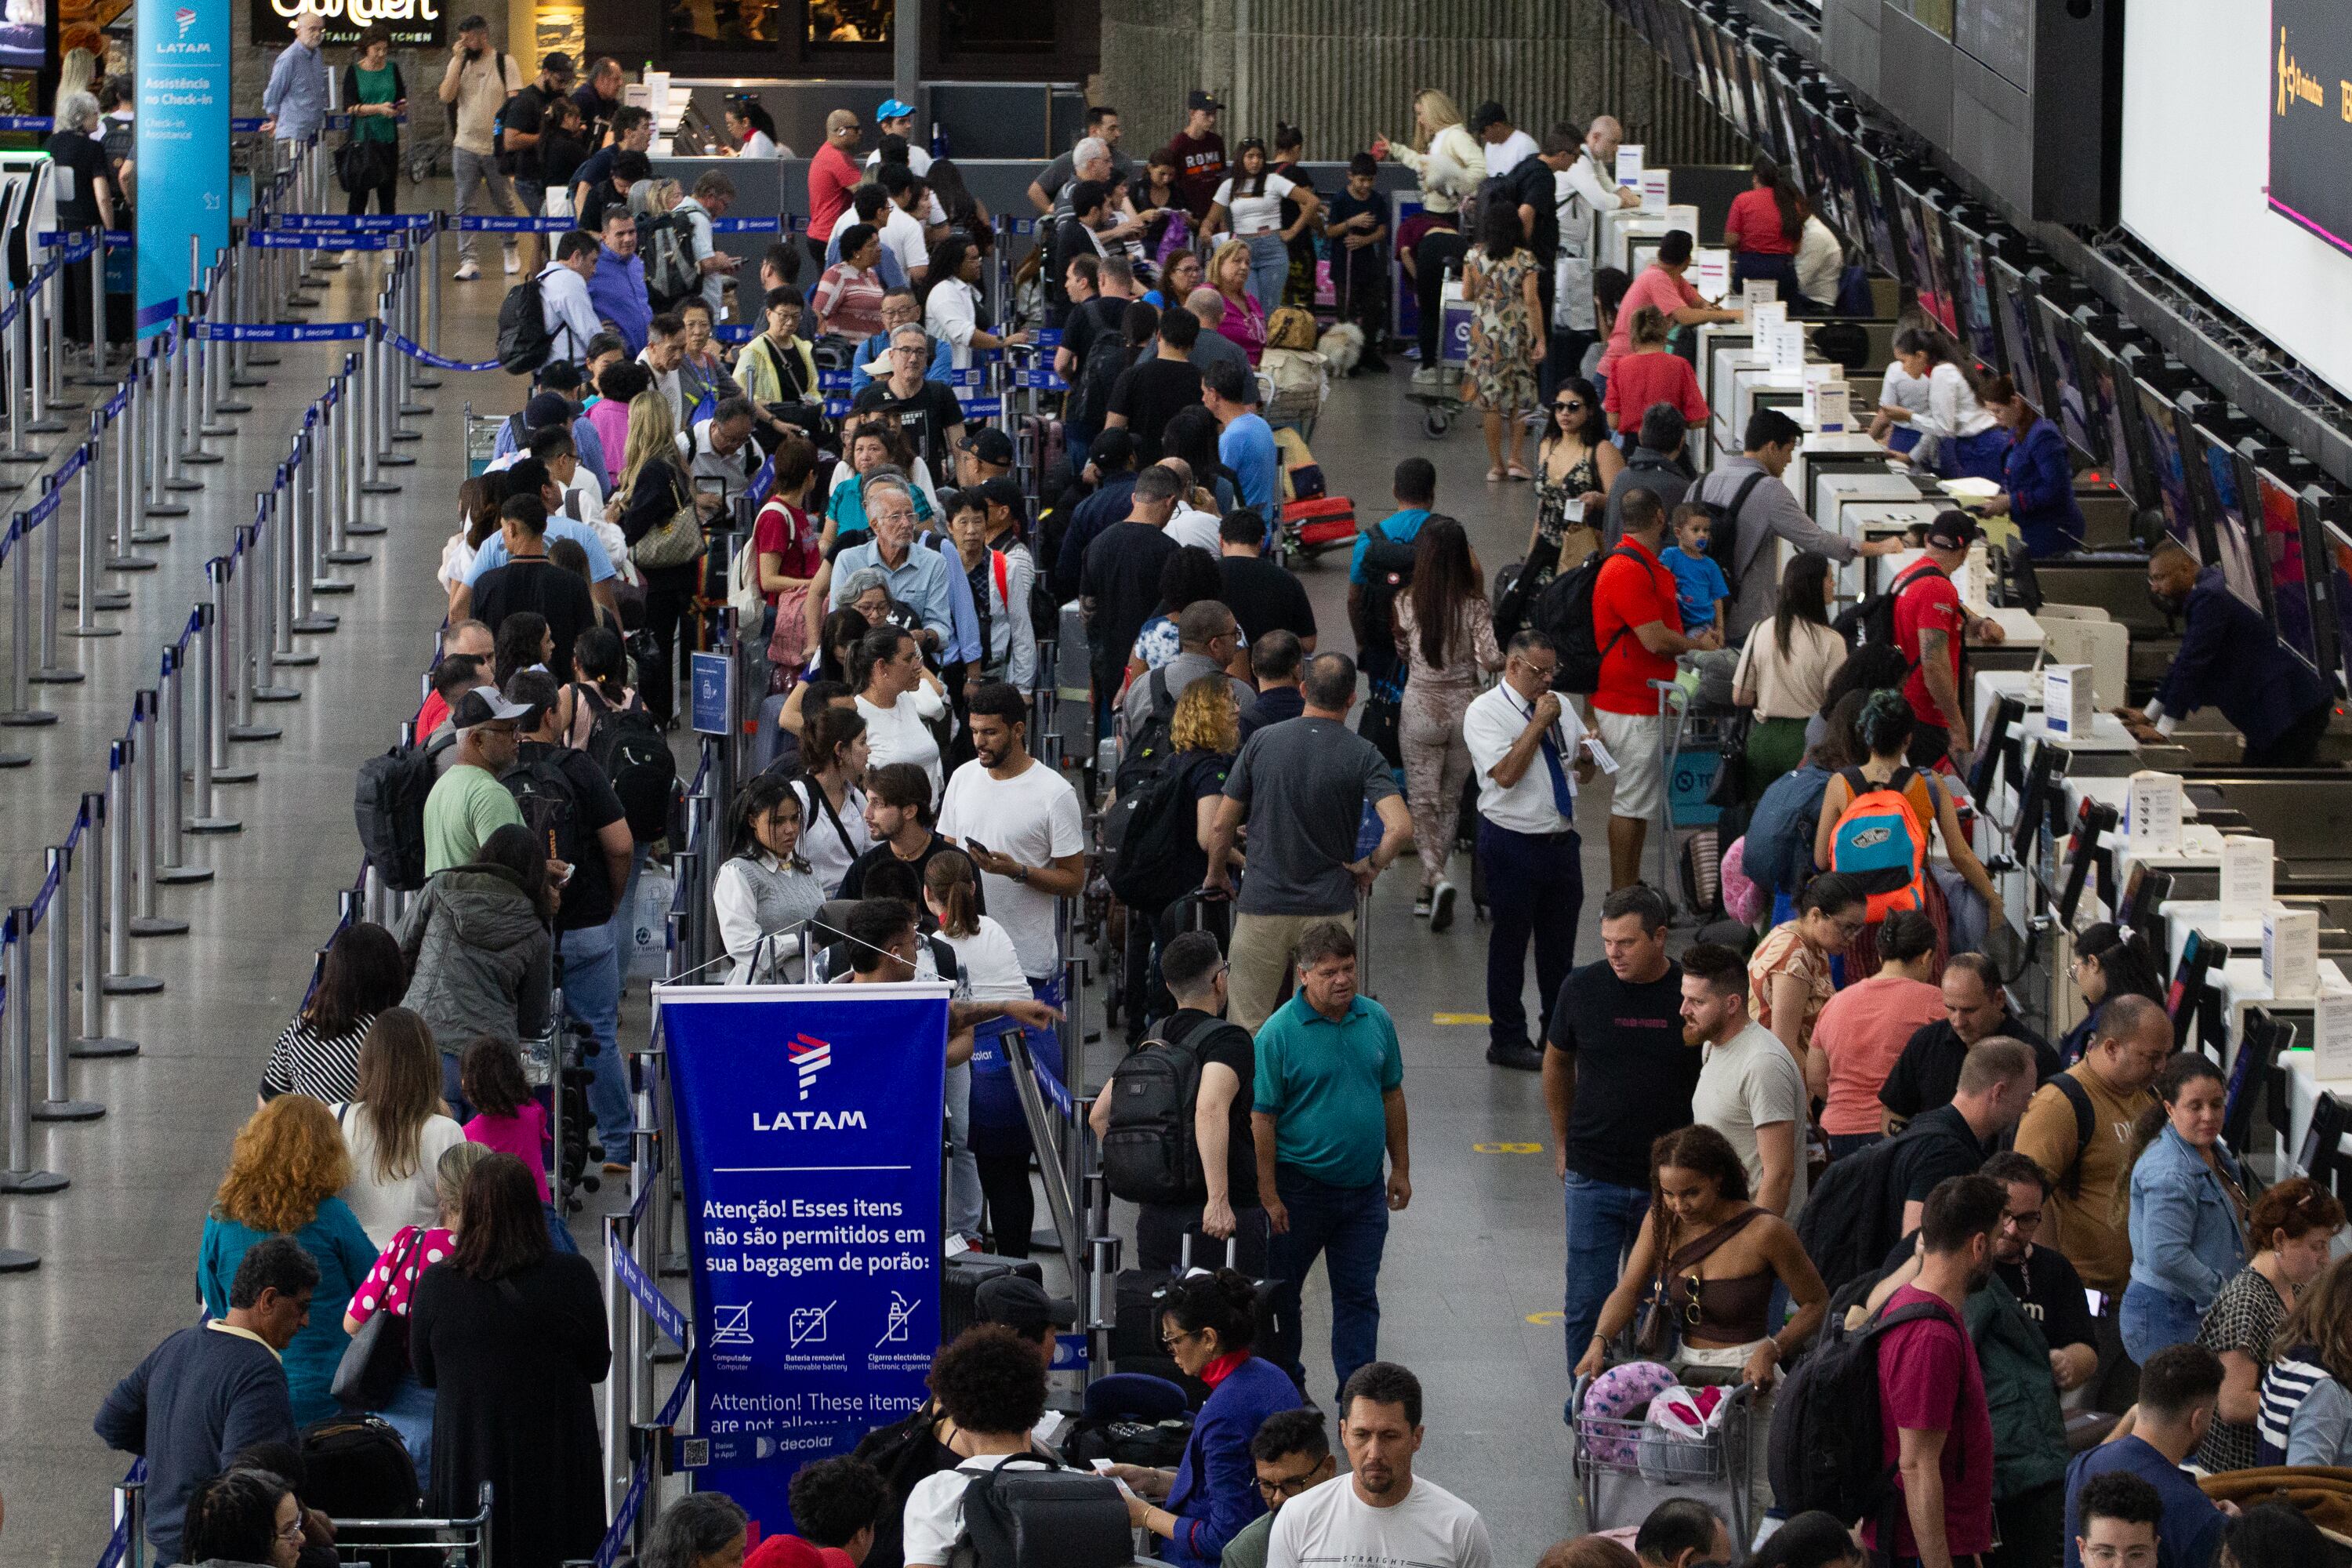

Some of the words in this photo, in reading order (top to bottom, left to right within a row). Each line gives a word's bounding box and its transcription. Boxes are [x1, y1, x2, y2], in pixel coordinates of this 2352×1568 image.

[157, 43, 211, 53] LATAM
[145, 78, 210, 89] Assistência
[2301, 72, 2324, 107] minutos
[144, 96, 158, 104] no
[162, 93, 213, 105] Check-in
[971, 1049, 993, 1062] colar
[753, 1111, 867, 1131] LATAM
[702, 1200, 786, 1223] Atenção!
[793, 1200, 848, 1217] Esses
[854, 1198, 902, 1216] itens
[704, 1227, 738, 1245] não
[743, 1226, 777, 1245] são
[782, 1225, 889, 1250] permitidos
[895, 1229, 925, 1243] em
[706, 1256, 737, 1272] sua
[742, 1253, 833, 1277] bagagem
[839, 1252, 862, 1271] de
[869, 1252, 930, 1276] porão:
[713, 1353, 752, 1363] Computador
[868, 1353, 892, 1363] Cigarro
[717, 1363, 748, 1371] Computer
[784, 1363, 822, 1371] Removable
[822, 1363, 848, 1372] battery
[902, 1363, 931, 1372] cigarette
[710, 1393, 801, 1411] Attention!
[808, 1392, 862, 1410] These
[869, 1393, 920, 1410] items
[710, 1419, 739, 1434] are
[746, 1417, 775, 1430] not
[715, 1443, 734, 1452] Baixe
[780, 1436, 833, 1451] decolar
[720, 1450, 737, 1461] App!
[1342, 1555, 1406, 1566] STRAIGHT
